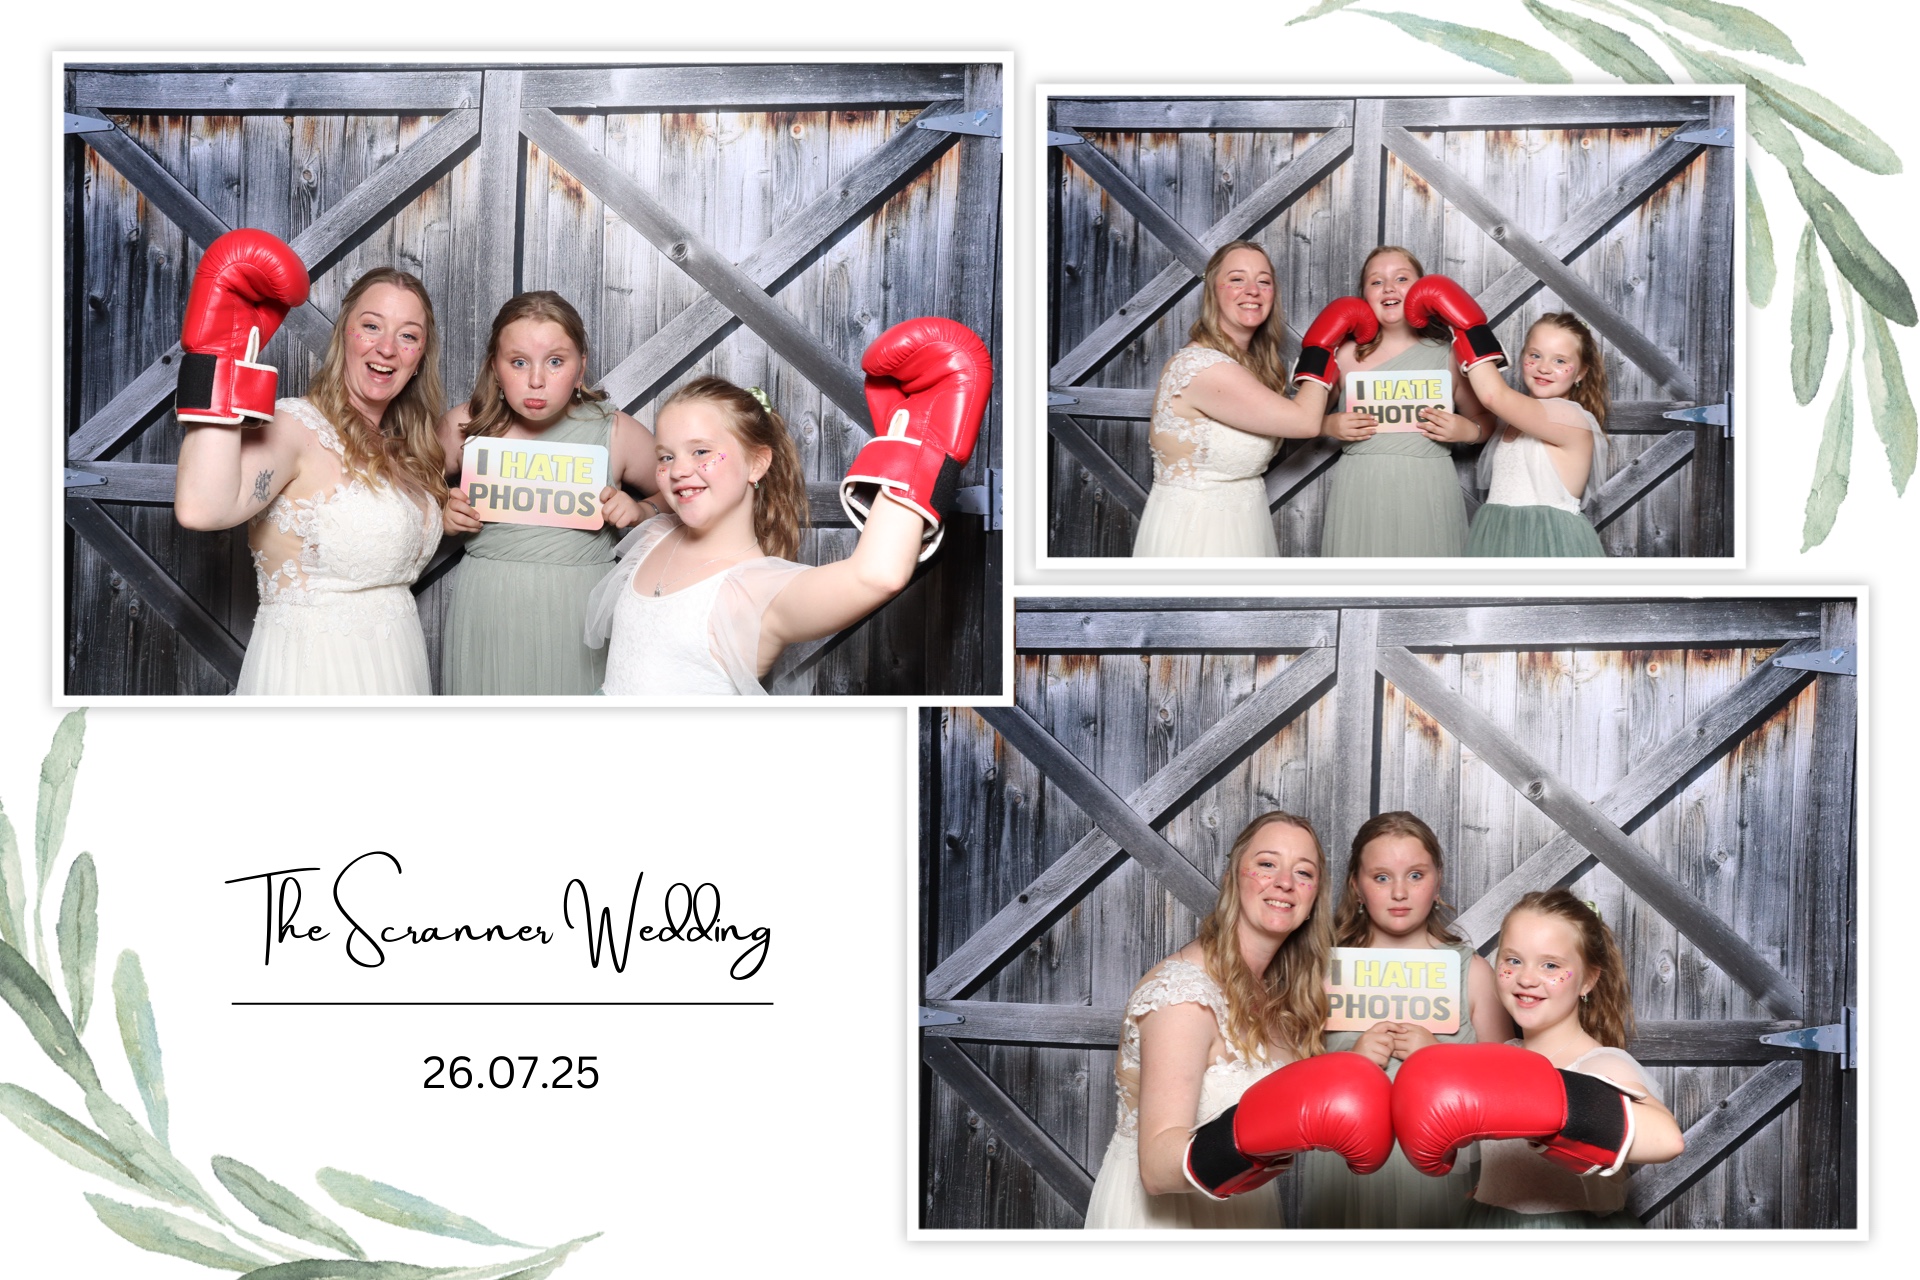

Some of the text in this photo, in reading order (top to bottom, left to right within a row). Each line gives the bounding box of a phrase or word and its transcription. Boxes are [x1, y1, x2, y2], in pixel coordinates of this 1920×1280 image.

[1356, 379, 1442, 400] I HATE
[476, 449, 594, 485] I HATE
[469, 482, 596, 517] PHOTOS
[1331, 959, 1447, 989] I HATE
[1327, 993, 1451, 1021] PHOTOS
